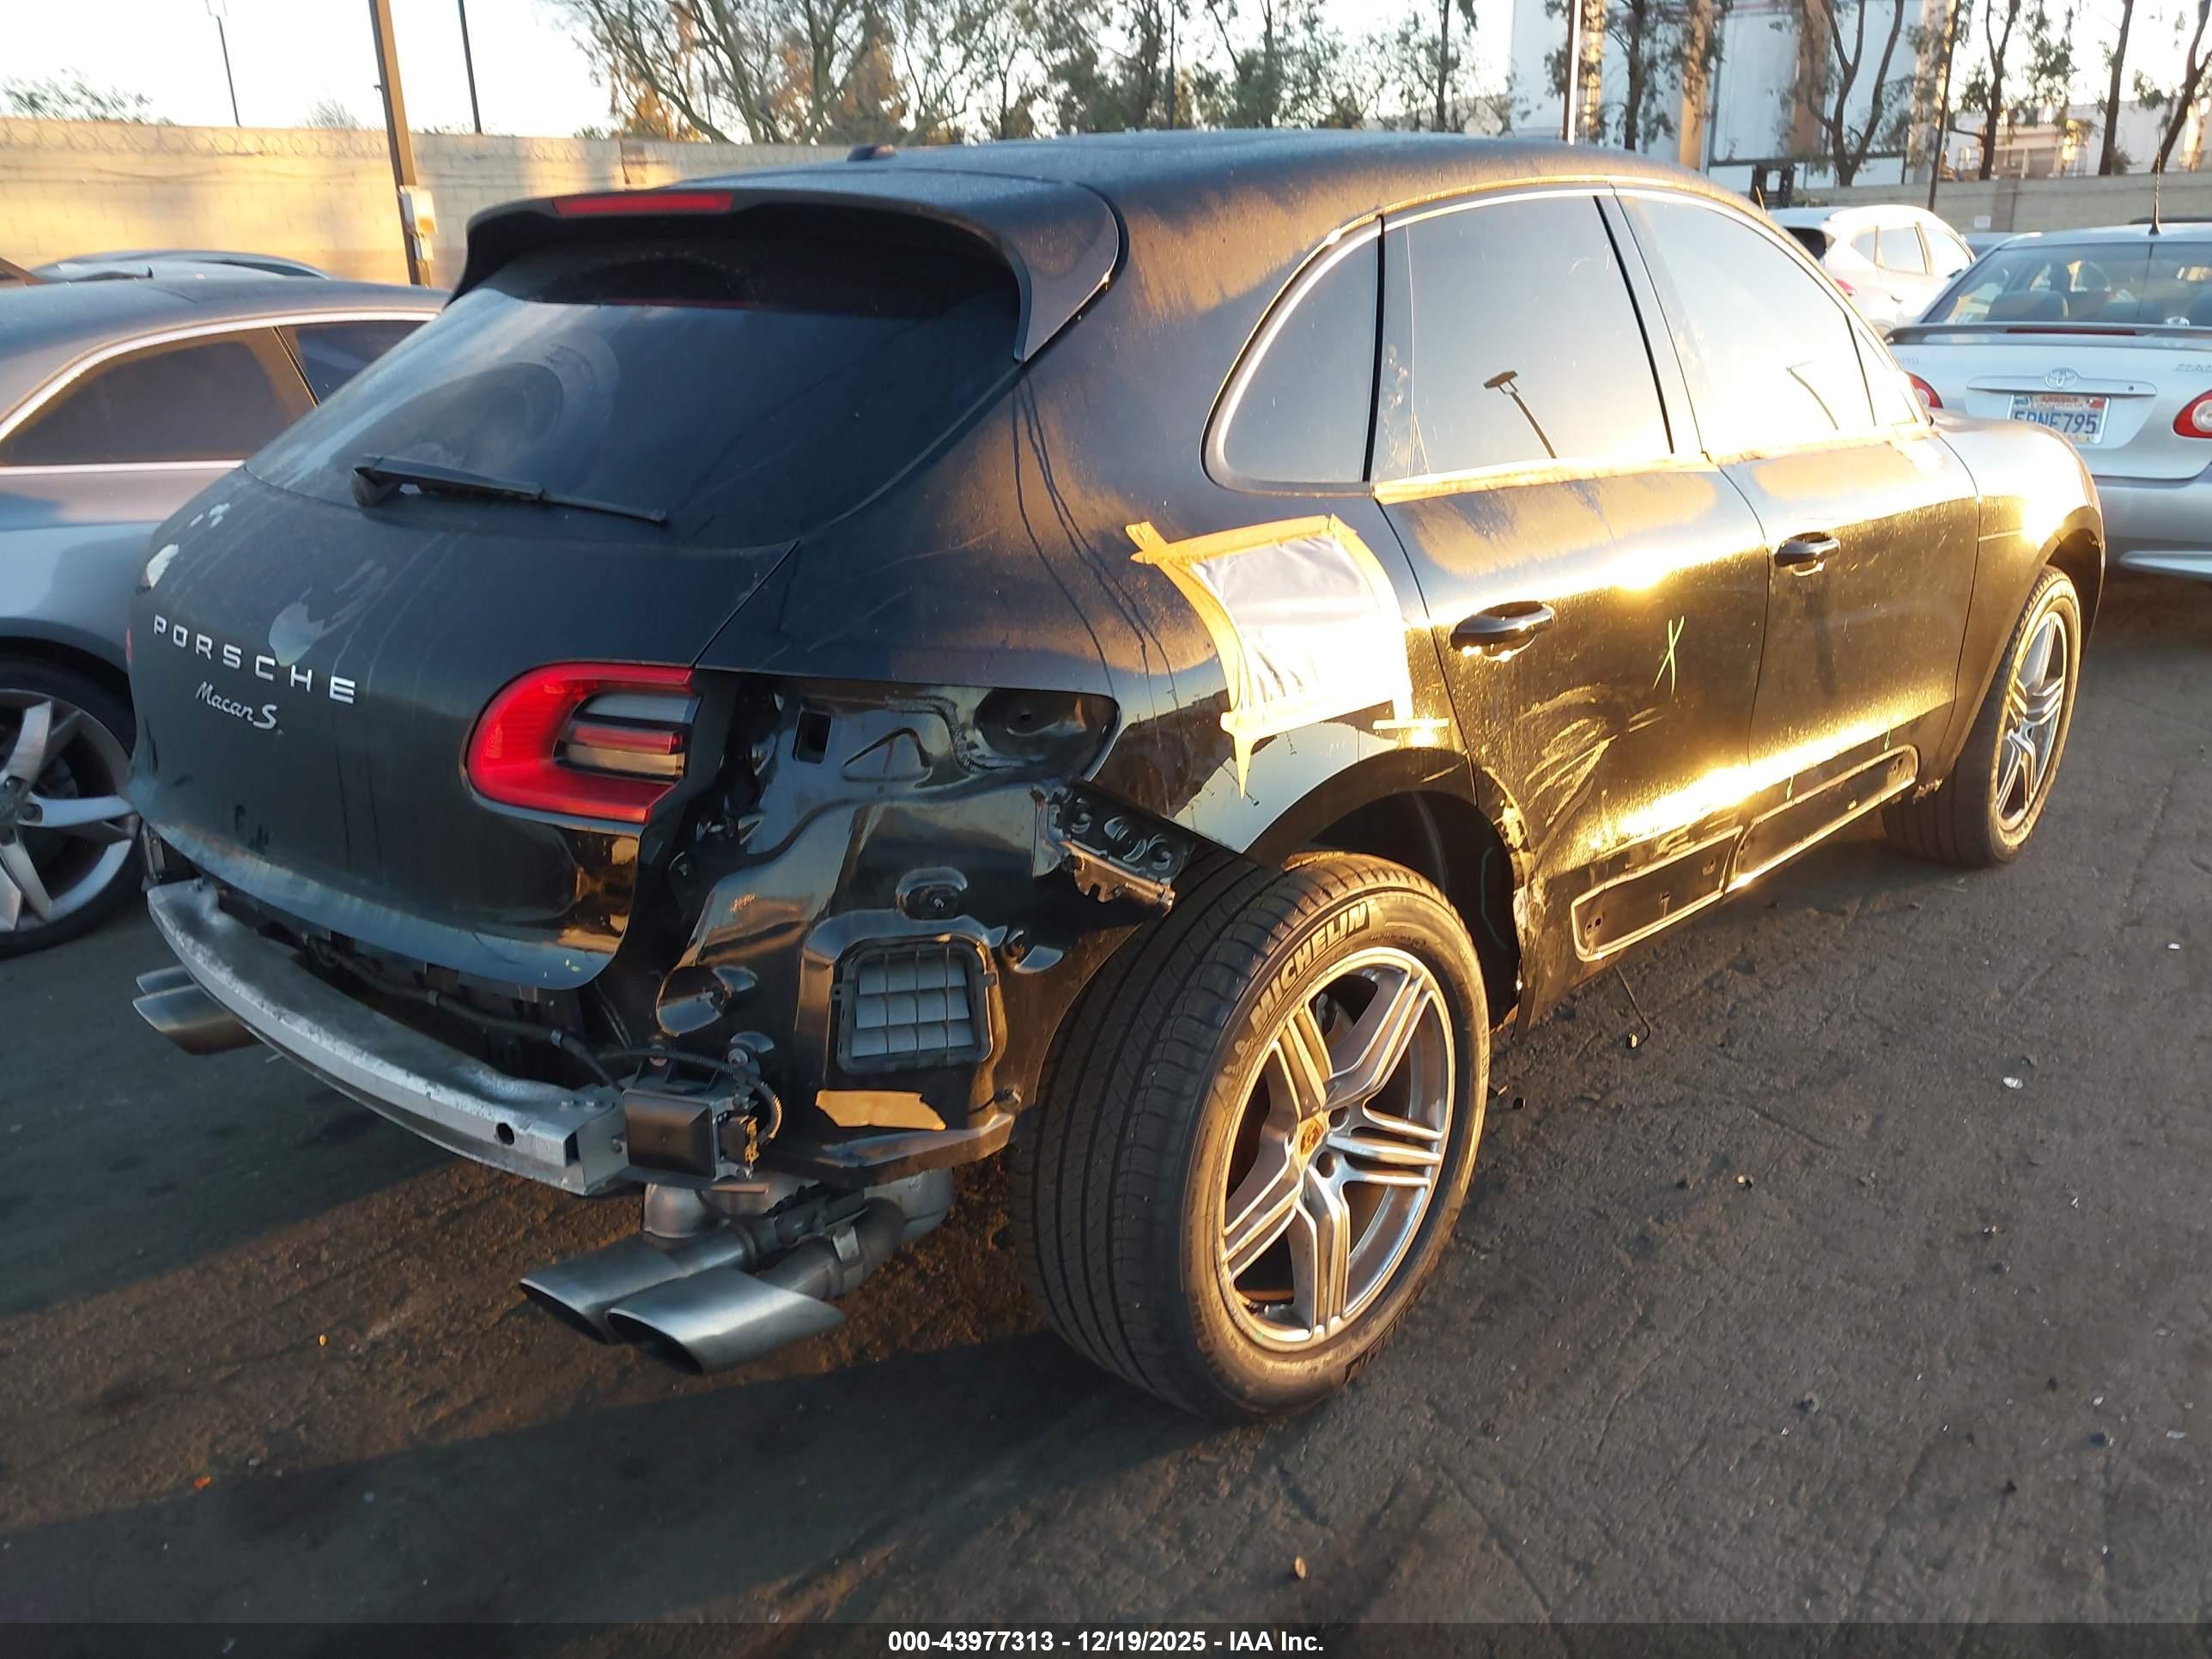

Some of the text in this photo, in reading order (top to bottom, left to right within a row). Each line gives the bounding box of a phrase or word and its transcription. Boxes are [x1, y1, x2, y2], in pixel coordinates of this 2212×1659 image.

[153, 614, 356, 704] PORSCHE
[196, 680, 277, 730] Macan S
[1249, 901, 1370, 1034] MICHELIN
